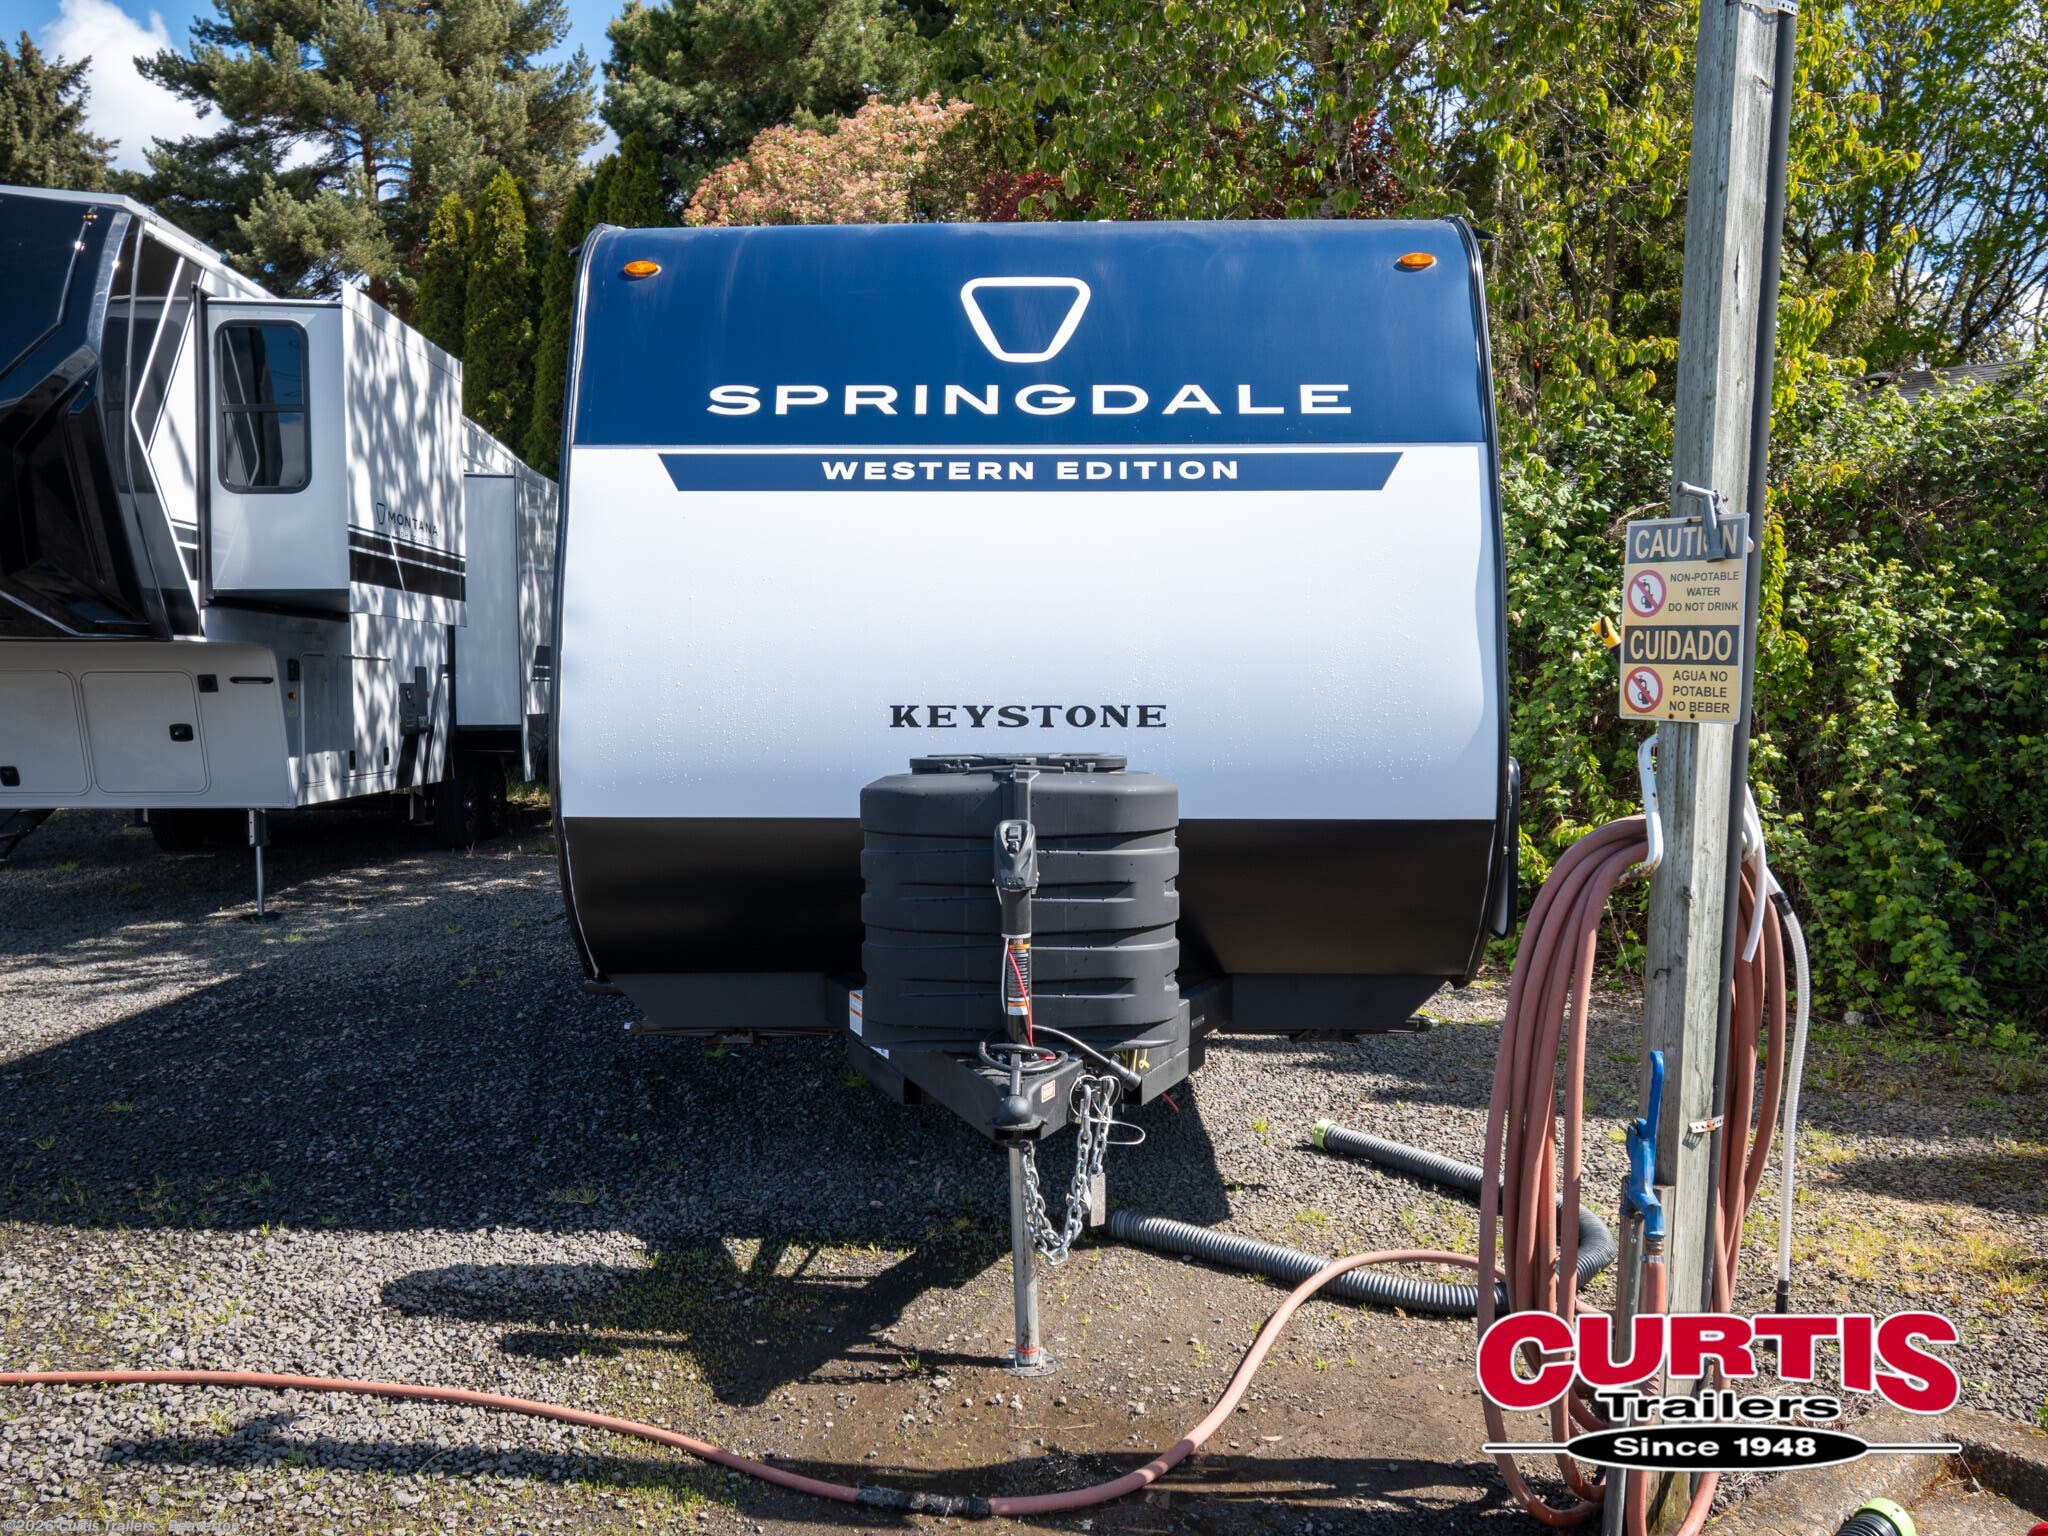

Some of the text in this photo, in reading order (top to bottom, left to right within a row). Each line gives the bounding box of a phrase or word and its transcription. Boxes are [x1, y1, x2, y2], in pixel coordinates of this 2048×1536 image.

[707, 383, 1352, 416] SPRINGDALE
[822, 461, 1238, 481] WESTERN EDITION
[387, 511, 439, 537] MONTANA
[1670, 571, 1740, 582] NON-POTABLE
[1686, 587, 1721, 597] WATER
[1668, 602, 1739, 612] DO NOT DRINK
[1630, 629, 1732, 662] CUIDADO
[1672, 670, 1728, 682] AGUA NO
[1672, 685, 1728, 698] POTABLE
[1669, 700, 1731, 714] NO BEBER
[889, 705, 1167, 728] KEYSTONE
